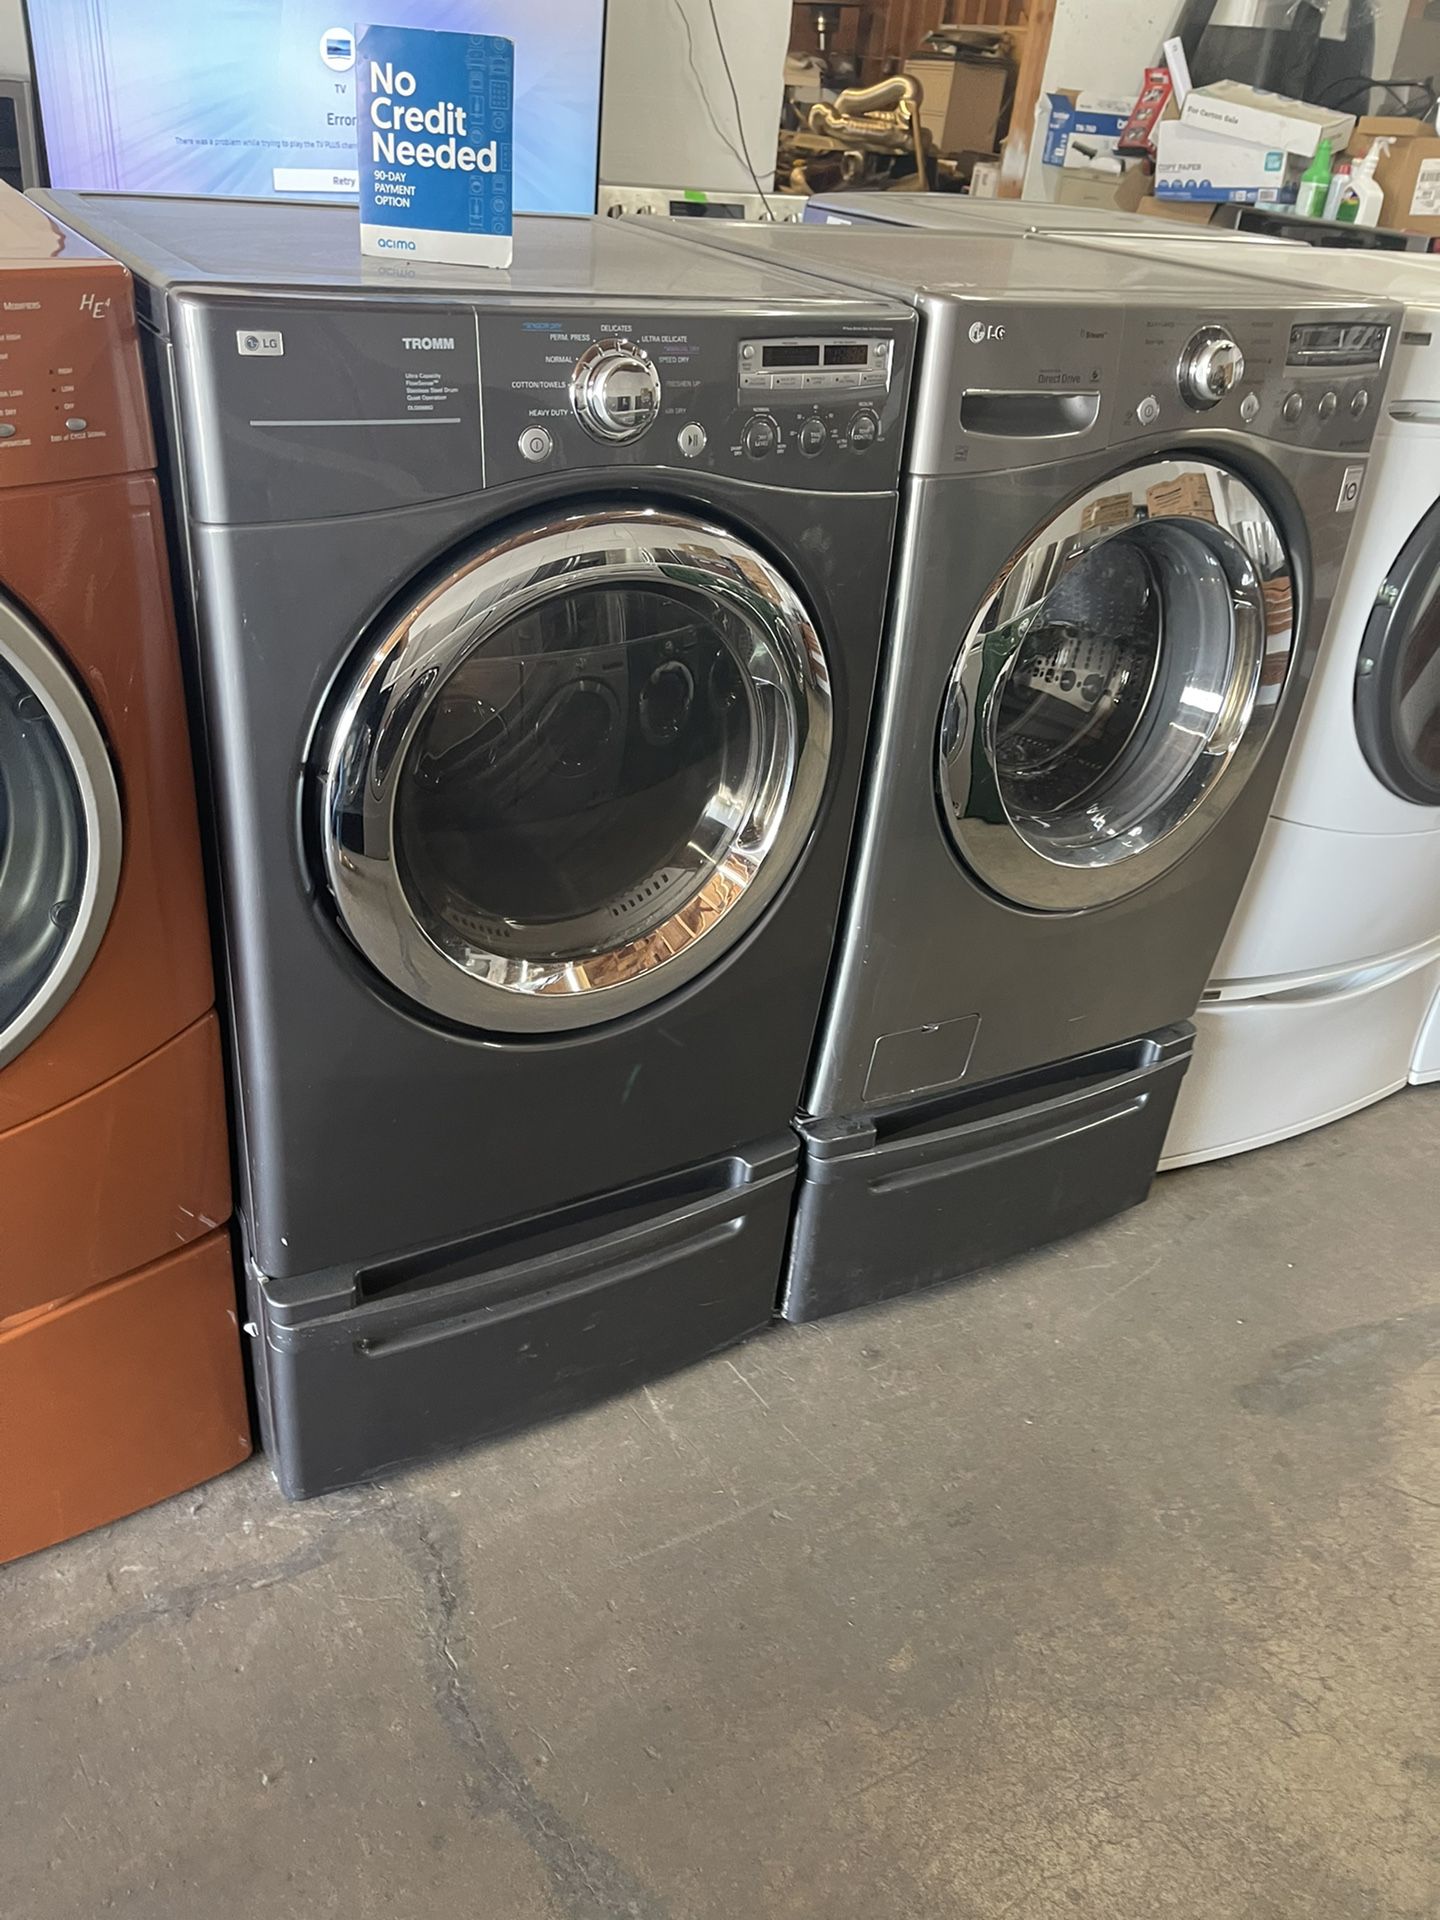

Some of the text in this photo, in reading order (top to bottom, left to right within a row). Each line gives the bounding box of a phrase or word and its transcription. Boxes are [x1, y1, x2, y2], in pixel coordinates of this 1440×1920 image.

[370, 61, 416, 97] No
[334, 84, 347, 94] TV
[1187, 105, 1199, 114] For
[326, 112, 357, 127] Error
[370, 97, 467, 136] Credit
[175, 136, 194, 146] There
[195, 138, 209, 146] was
[214, 137, 242, 148] problem
[243, 138, 260, 147] while
[261, 139, 281, 149] trying
[290, 140, 303, 150] play
[304, 140, 315, 149] the
[316, 140, 325, 149] TV
[372, 131, 497, 173] Needed
[332, 176, 356, 188] Retry
[374, 170, 407, 183] 90-DAY
[374, 183, 416, 196] PAYMENT
[374, 195, 411, 208] OPTION
[377, 238, 416, 251] acima
[600, 324, 633, 332] DELICATES
[986, 324, 1006, 341] LG
[262, 338, 278, 349] LG
[401, 337, 455, 350] TROMM
[570, 334, 590, 342] PRESS
[641, 335, 688, 343] ULTRA DELICATE
[545, 355, 573, 363] NORMAL
[1038, 373, 1081, 384] Direct Drive
[528, 408, 568, 417] HEAVY DUTY
